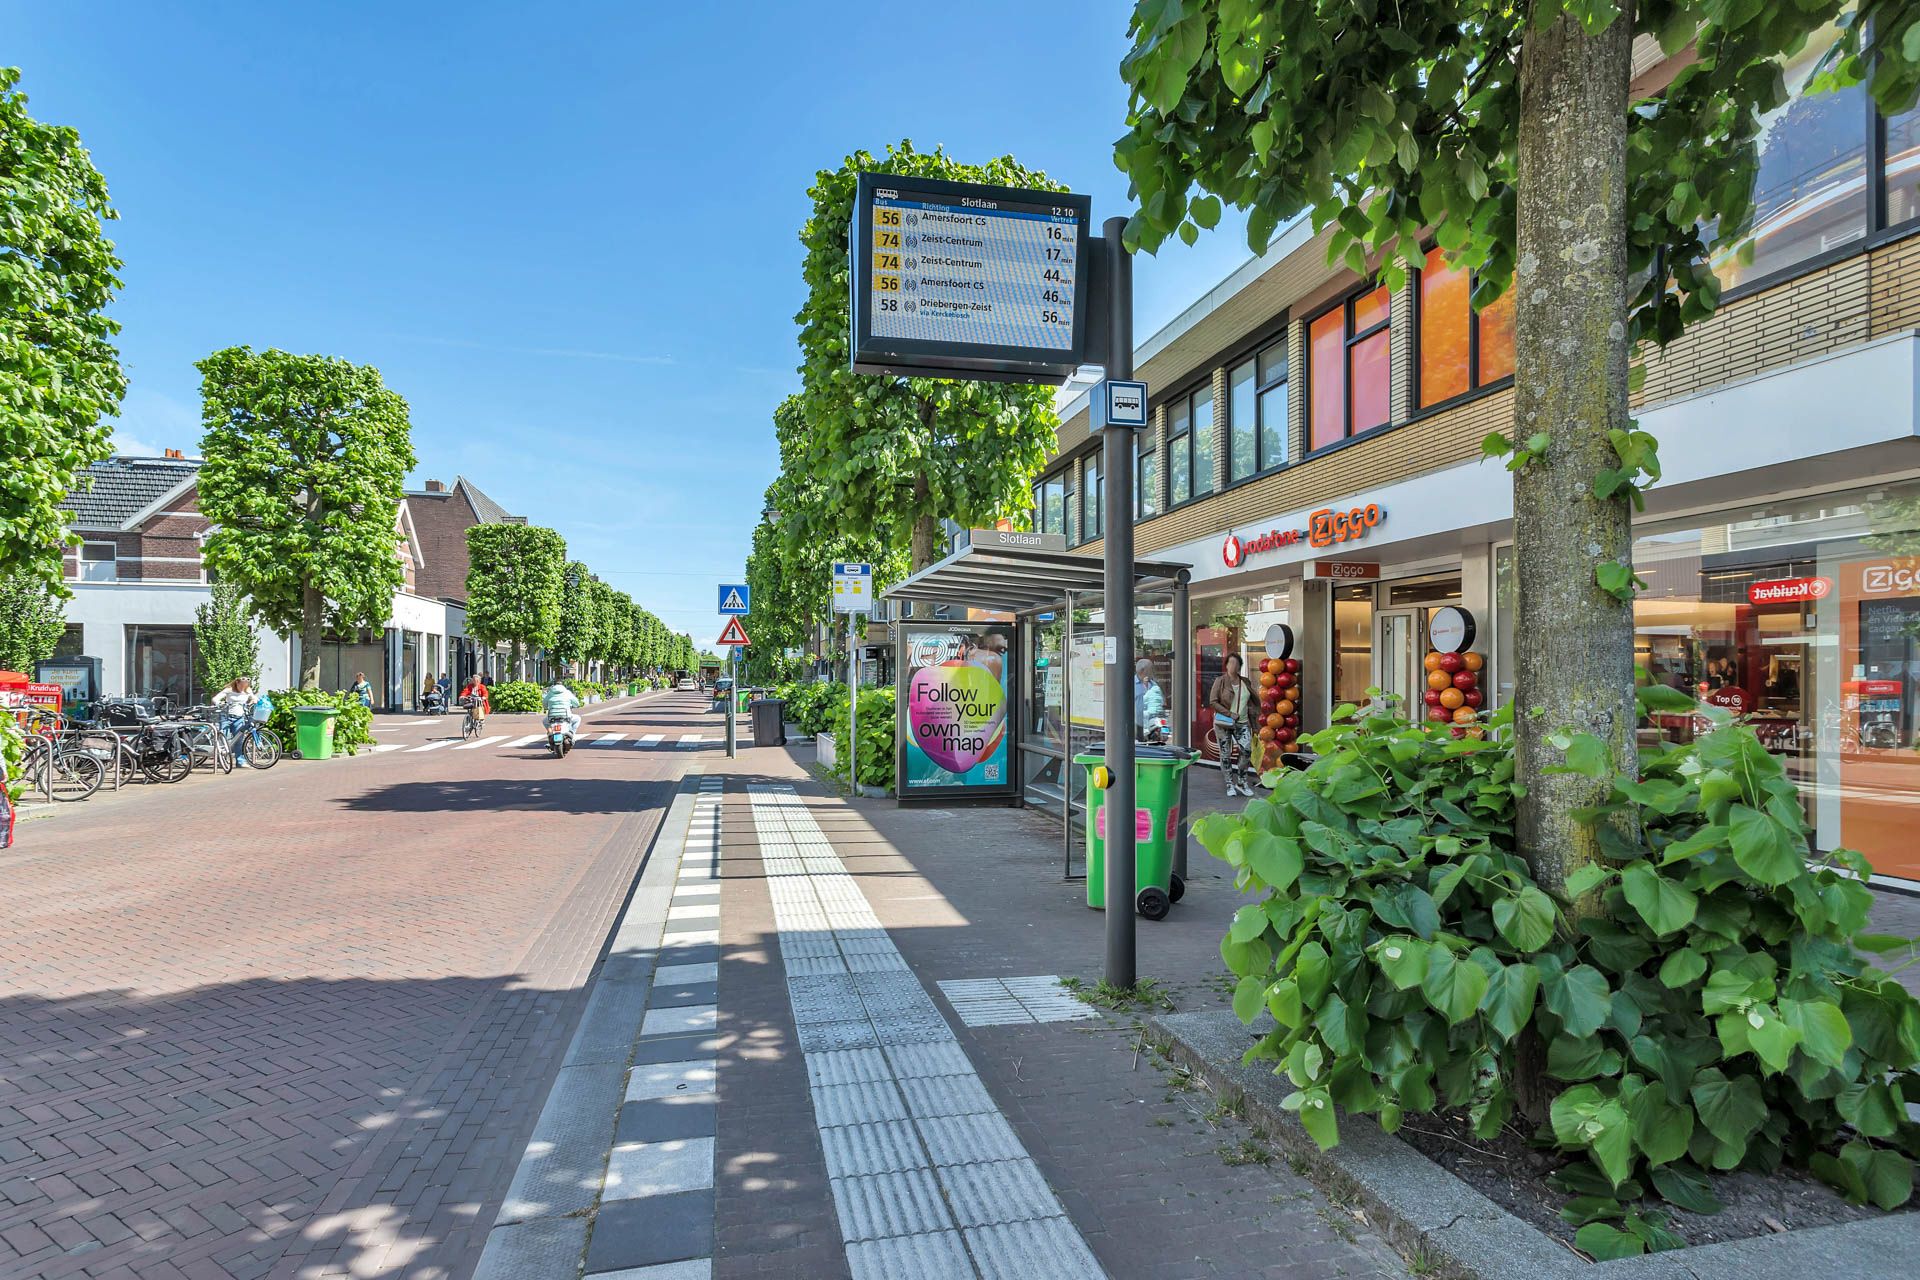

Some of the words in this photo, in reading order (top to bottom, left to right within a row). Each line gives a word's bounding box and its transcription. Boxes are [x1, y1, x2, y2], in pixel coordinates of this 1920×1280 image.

[875, 198, 888, 206] Bus
[961, 198, 998, 210] Slotlaan
[881, 212, 899, 226] 56
[922, 212, 972, 225] Amersfoort
[975, 217, 986, 226] CS
[1051, 207, 1061, 216] 12
[1064, 208, 1074, 217] 10
[1051, 215, 1073, 224] Vertrek
[881, 233, 899, 247] 74
[1046, 227, 1061, 240] 16
[921, 234, 983, 248] Zeist-Centrum
[1046, 248, 1061, 261] 17
[881, 255, 899, 269] 74
[921, 255, 982, 269] Zeist-Centrum
[1043, 269, 1060, 282] 44
[881, 277, 898, 291] 56
[920, 278, 971, 289] Amersfoort
[973, 282, 985, 290] CS
[1042, 290, 1059, 303] 46
[880, 298, 898, 312] 58
[920, 298, 992, 312] Driebergen-Zeist
[1042, 310, 1058, 323] 56
[999, 533, 1042, 545] Slotlaan
[1242, 529, 1299, 556] vodafone
[917, 682, 978, 702] Follow
[1716, 695, 1730, 704] Top
[955, 703, 997, 722] your
[919, 723, 960, 738] own
[943, 737, 984, 756] map
